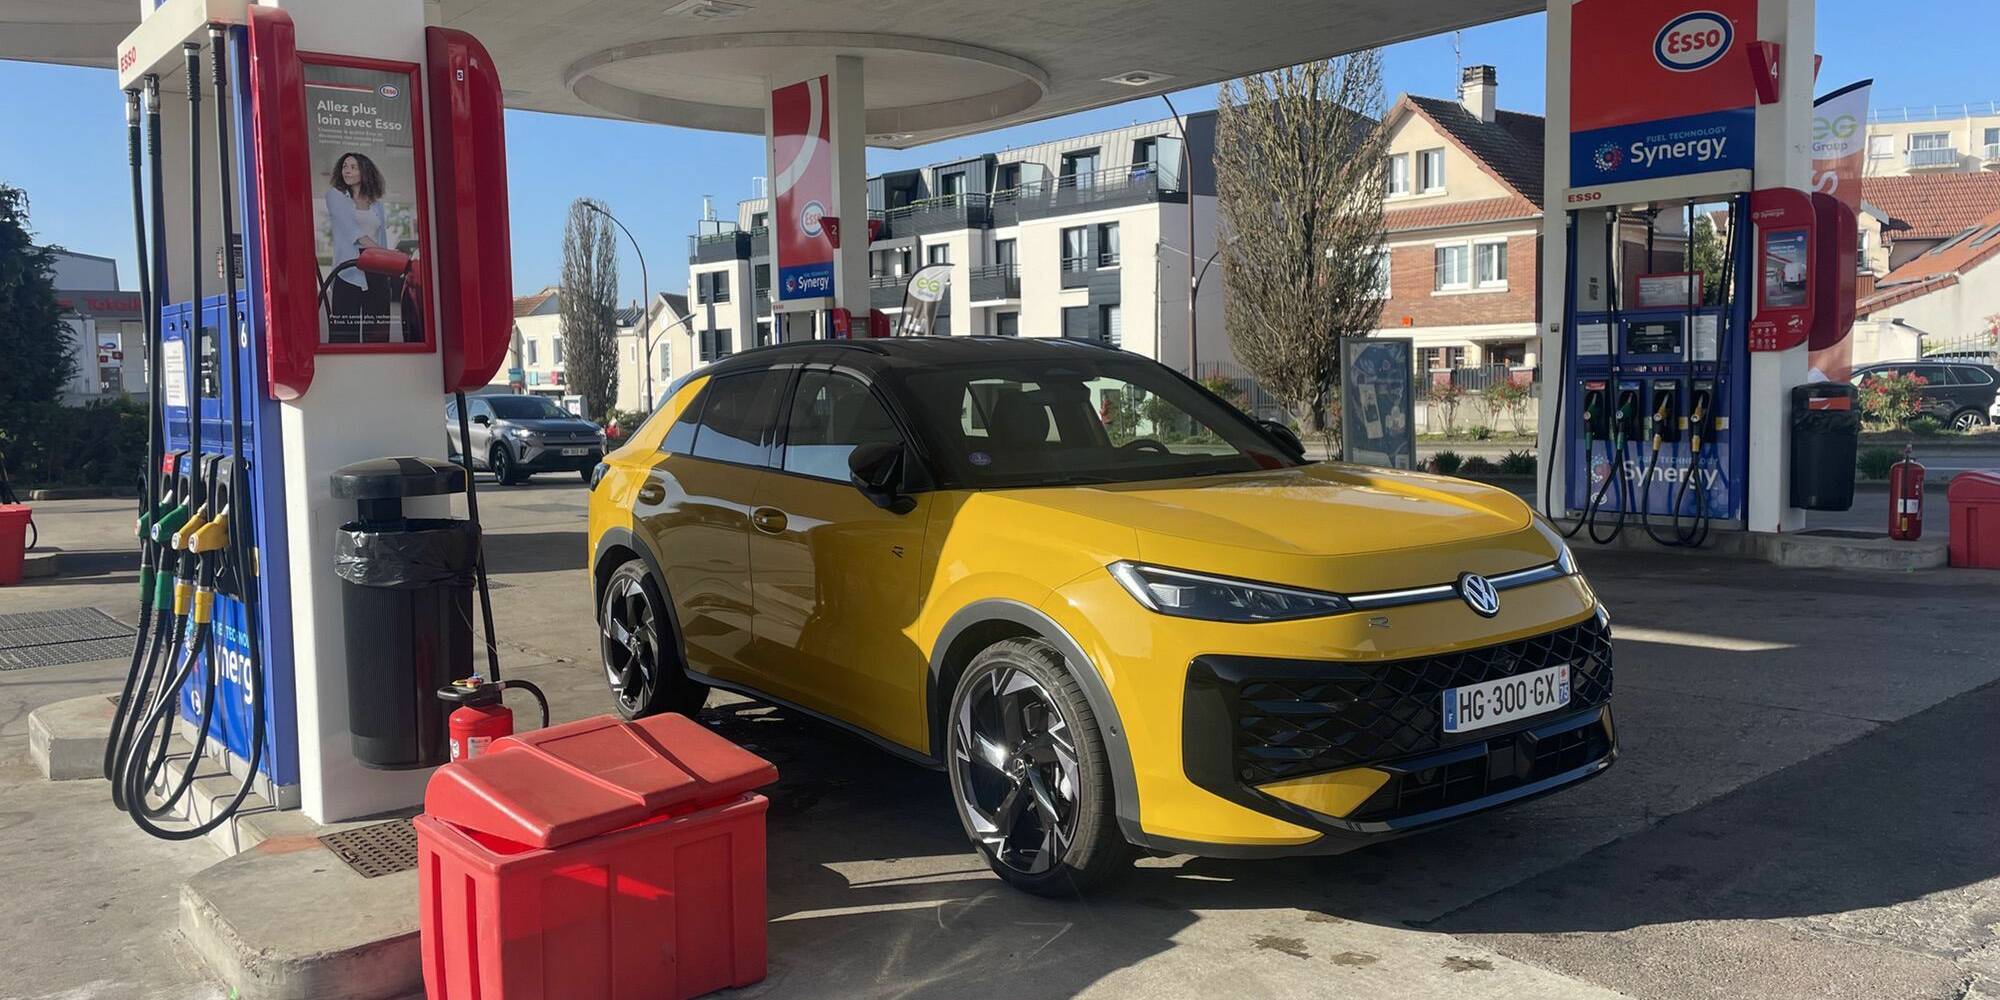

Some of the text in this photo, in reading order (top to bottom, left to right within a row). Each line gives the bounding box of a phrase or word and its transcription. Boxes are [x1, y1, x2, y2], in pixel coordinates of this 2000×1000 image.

[1667, 29, 1721, 54] Esso
[120, 46, 137, 73] ESSO
[1770, 62, 1778, 79] 4
[317, 100, 377, 116] Allez plus
[317, 112, 402, 130] loin avec Esso
[1646, 126, 1727, 143] FUEL TECHNOLOGY
[1630, 136, 1727, 168] Synergy
[1567, 192, 1601, 203] ESSO
[831, 224, 838, 236] 2
[798, 276, 830, 293] Synergy
[240, 322, 248, 348] 6
[213, 645, 254, 705] ynerg
[1459, 672, 1555, 724] HG-300-GX
[1559, 684, 1569, 701] 75
[1448, 712, 1454, 723] F
